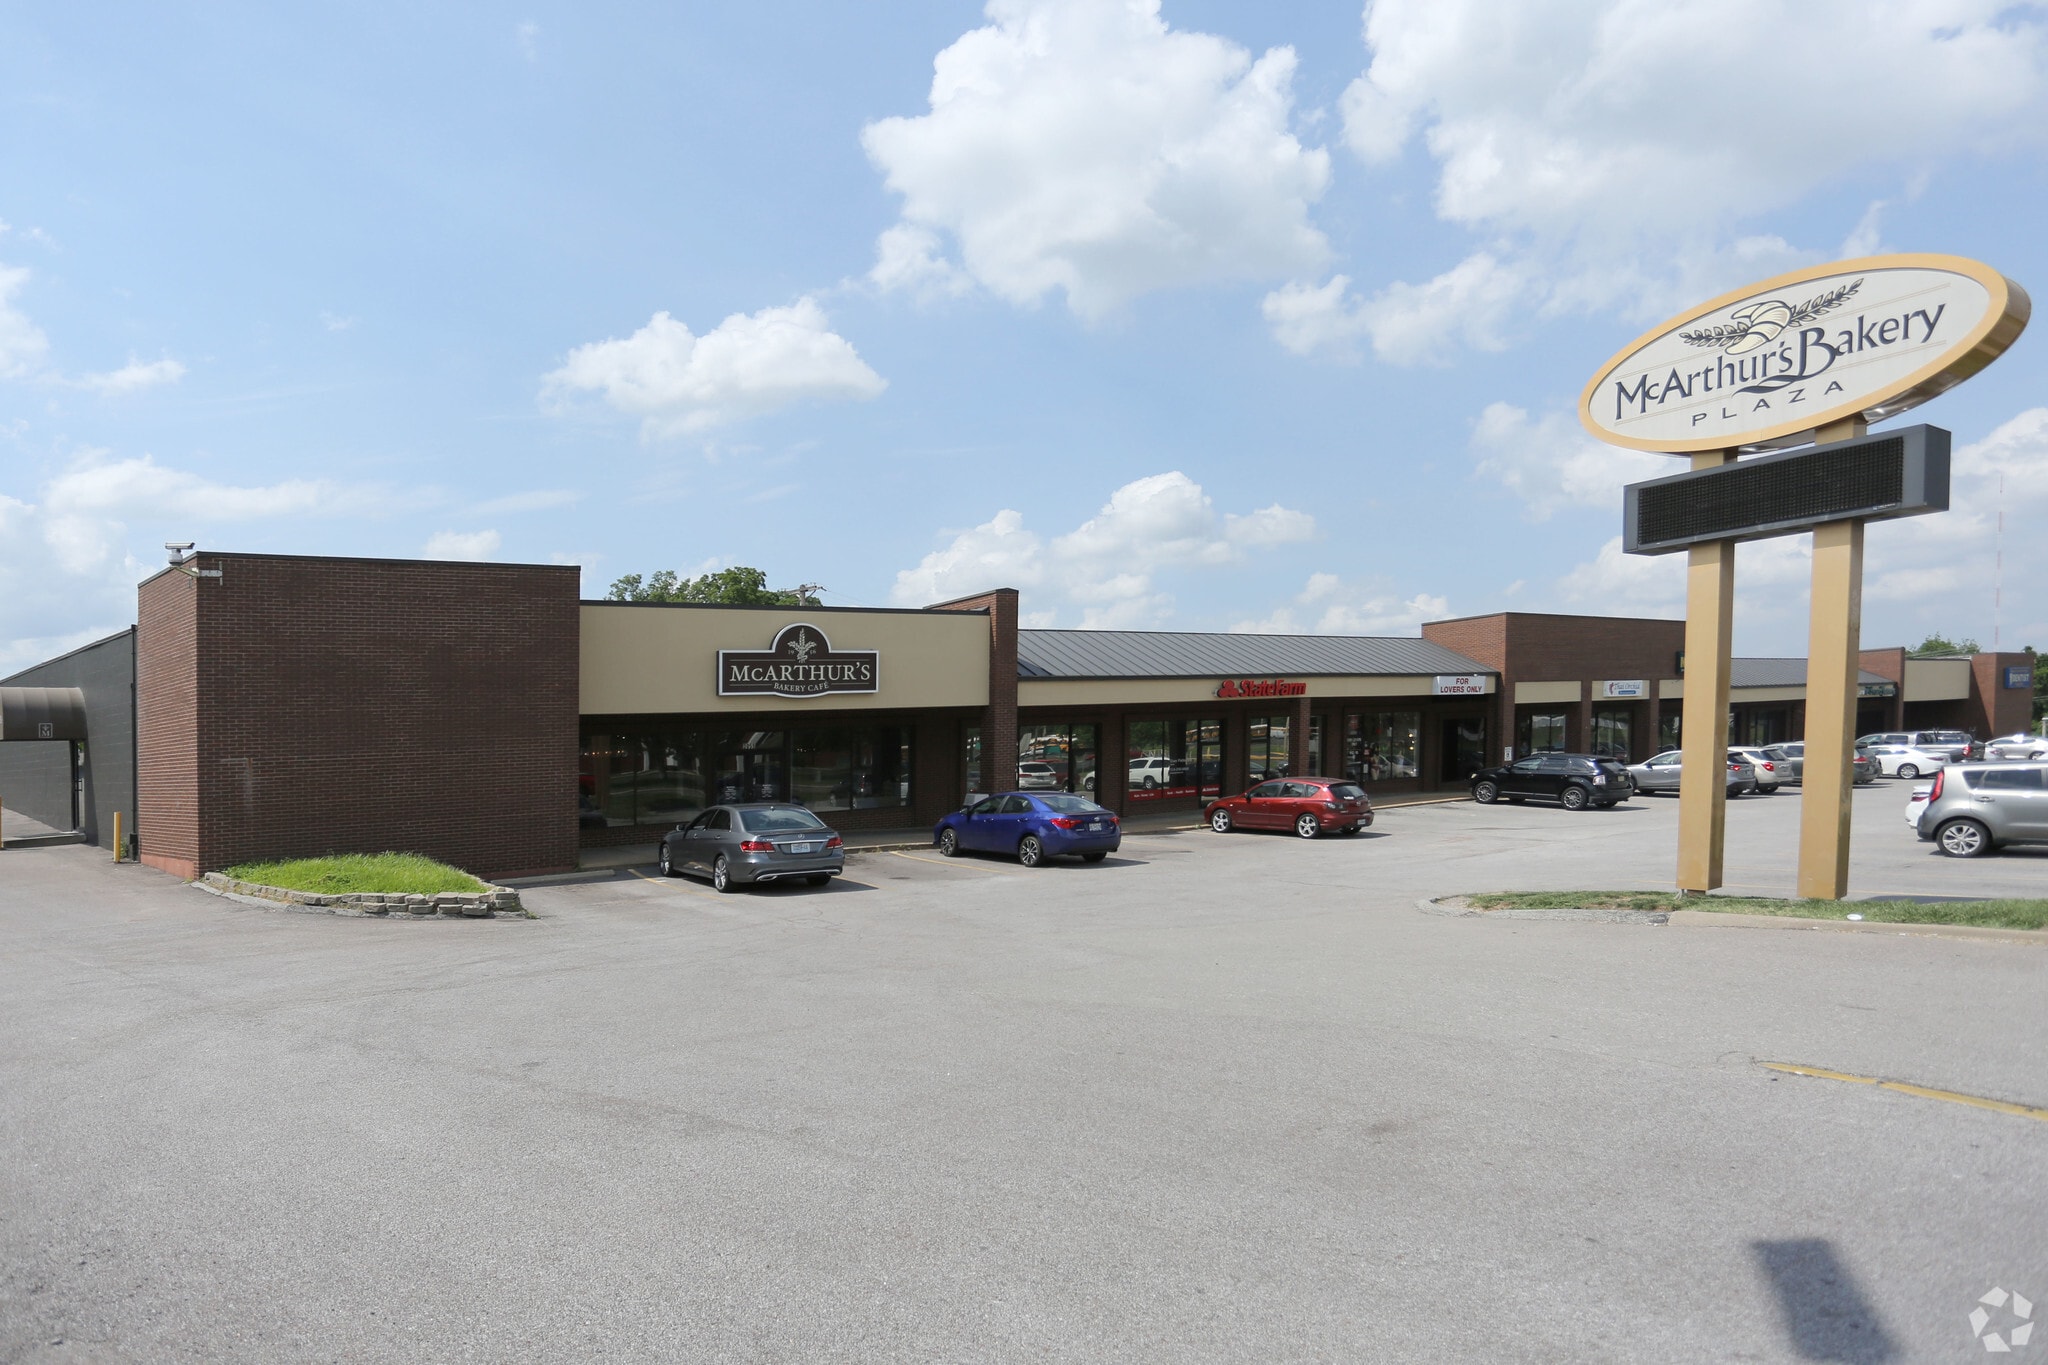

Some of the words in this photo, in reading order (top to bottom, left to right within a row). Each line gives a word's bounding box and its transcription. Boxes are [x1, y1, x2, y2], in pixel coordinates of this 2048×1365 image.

[1615, 341, 1793, 420] McArthur's
[1798, 303, 1946, 382] Bakery
[1692, 381, 1844, 426] PLAZA
[774, 682, 807, 692] BAKERY
[807, 681, 829, 692] CAFÉ
[1456, 677, 1469, 685] FOR
[1466, 685, 1483, 693] ONLY
